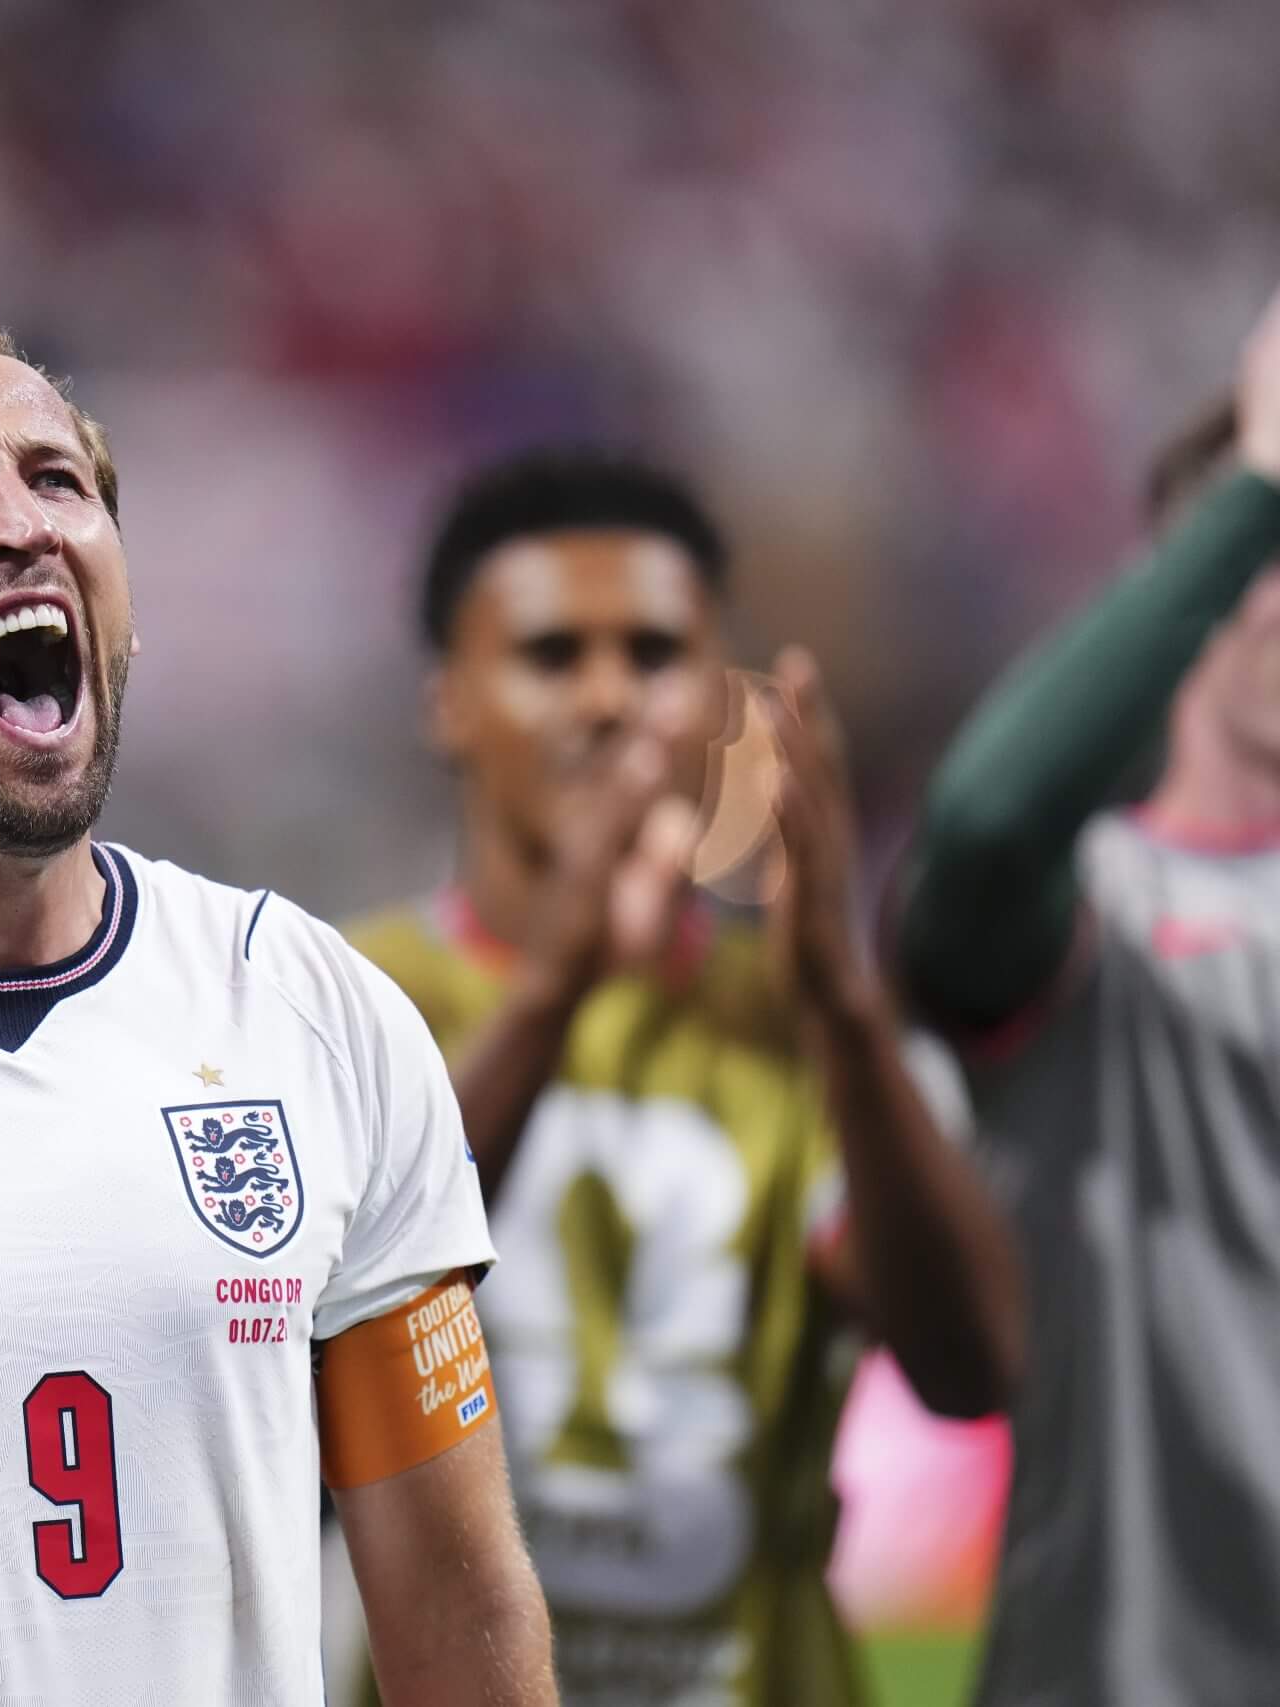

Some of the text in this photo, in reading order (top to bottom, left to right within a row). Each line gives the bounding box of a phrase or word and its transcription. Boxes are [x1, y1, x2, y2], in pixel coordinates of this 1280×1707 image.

[216, 1278, 302, 1304] CONGO DR
[228, 1317, 288, 1344] 01.07.2
[416, 1376, 457, 1416] the
[460, 1393, 487, 1422] FIFA
[22, 1369, 124, 1600] 9
